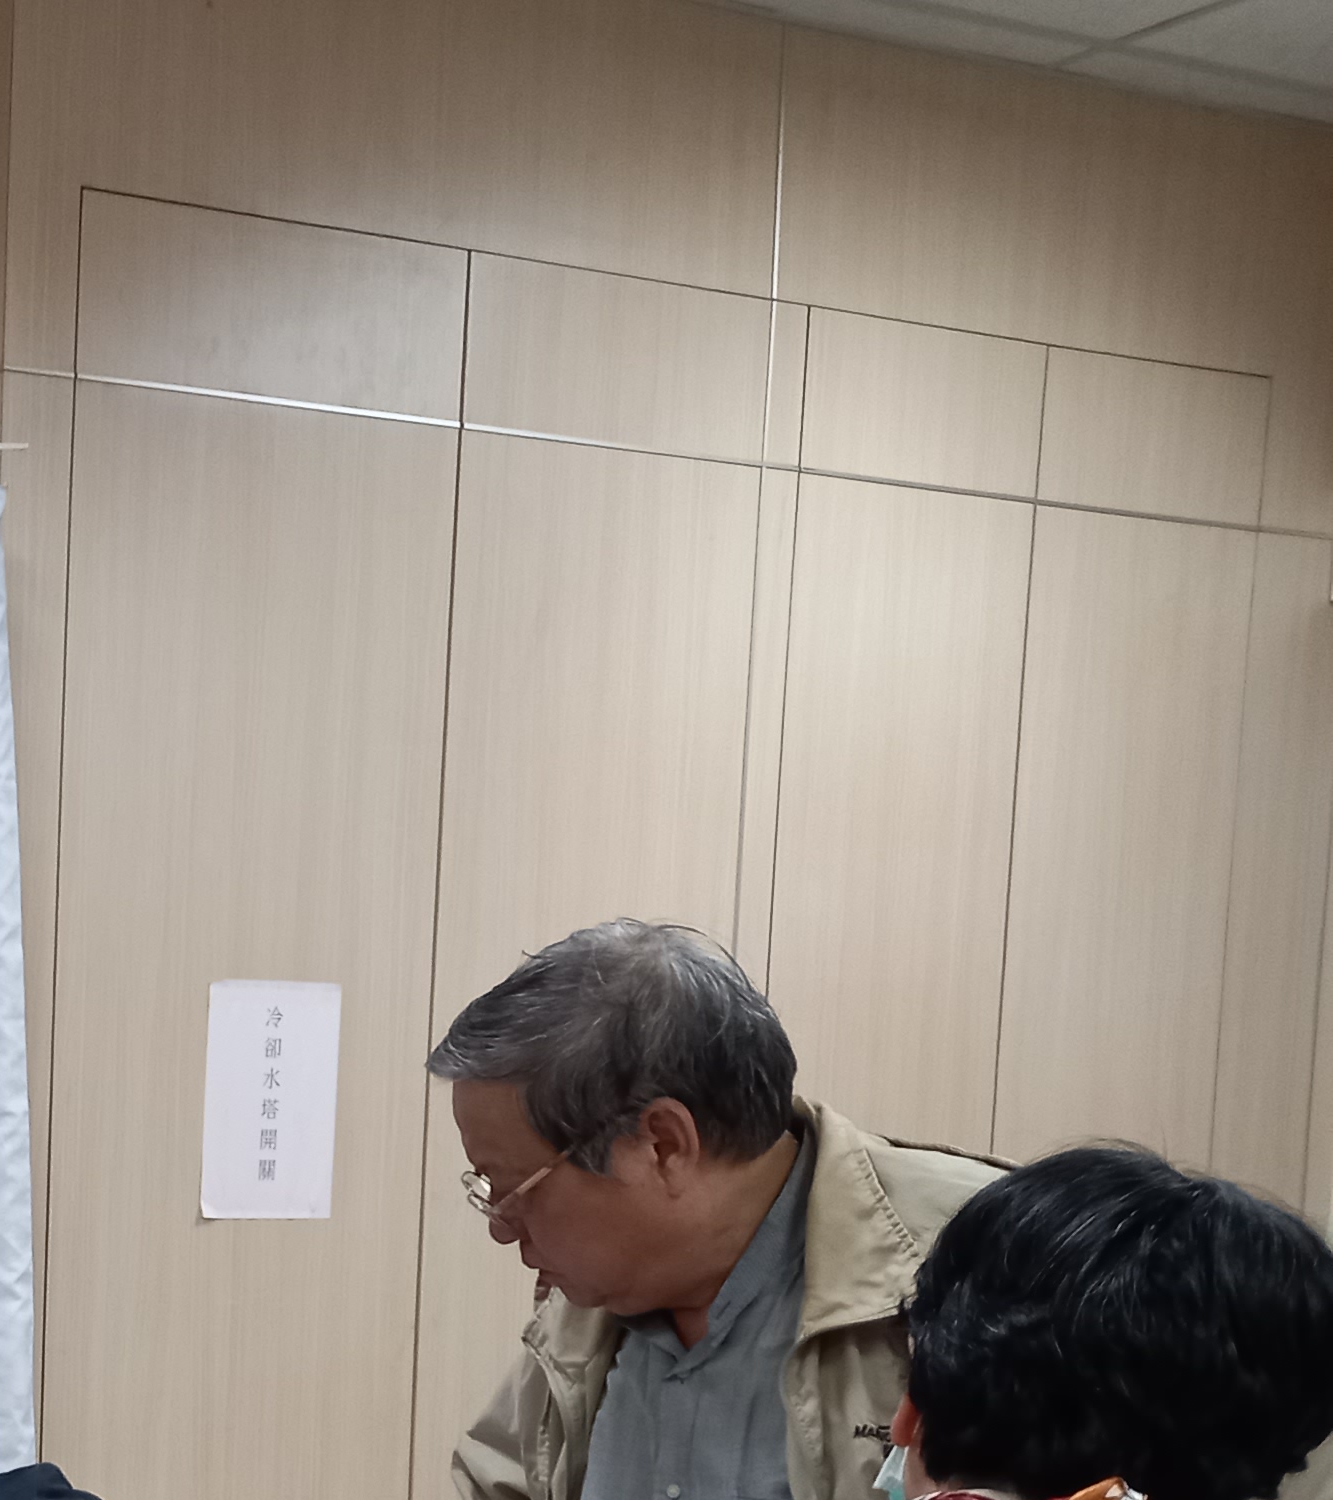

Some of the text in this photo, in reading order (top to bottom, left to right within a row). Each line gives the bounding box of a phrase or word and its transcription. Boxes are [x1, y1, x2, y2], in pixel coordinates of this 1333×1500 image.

[258, 1005, 284, 1181] 冷卻水塔開關
